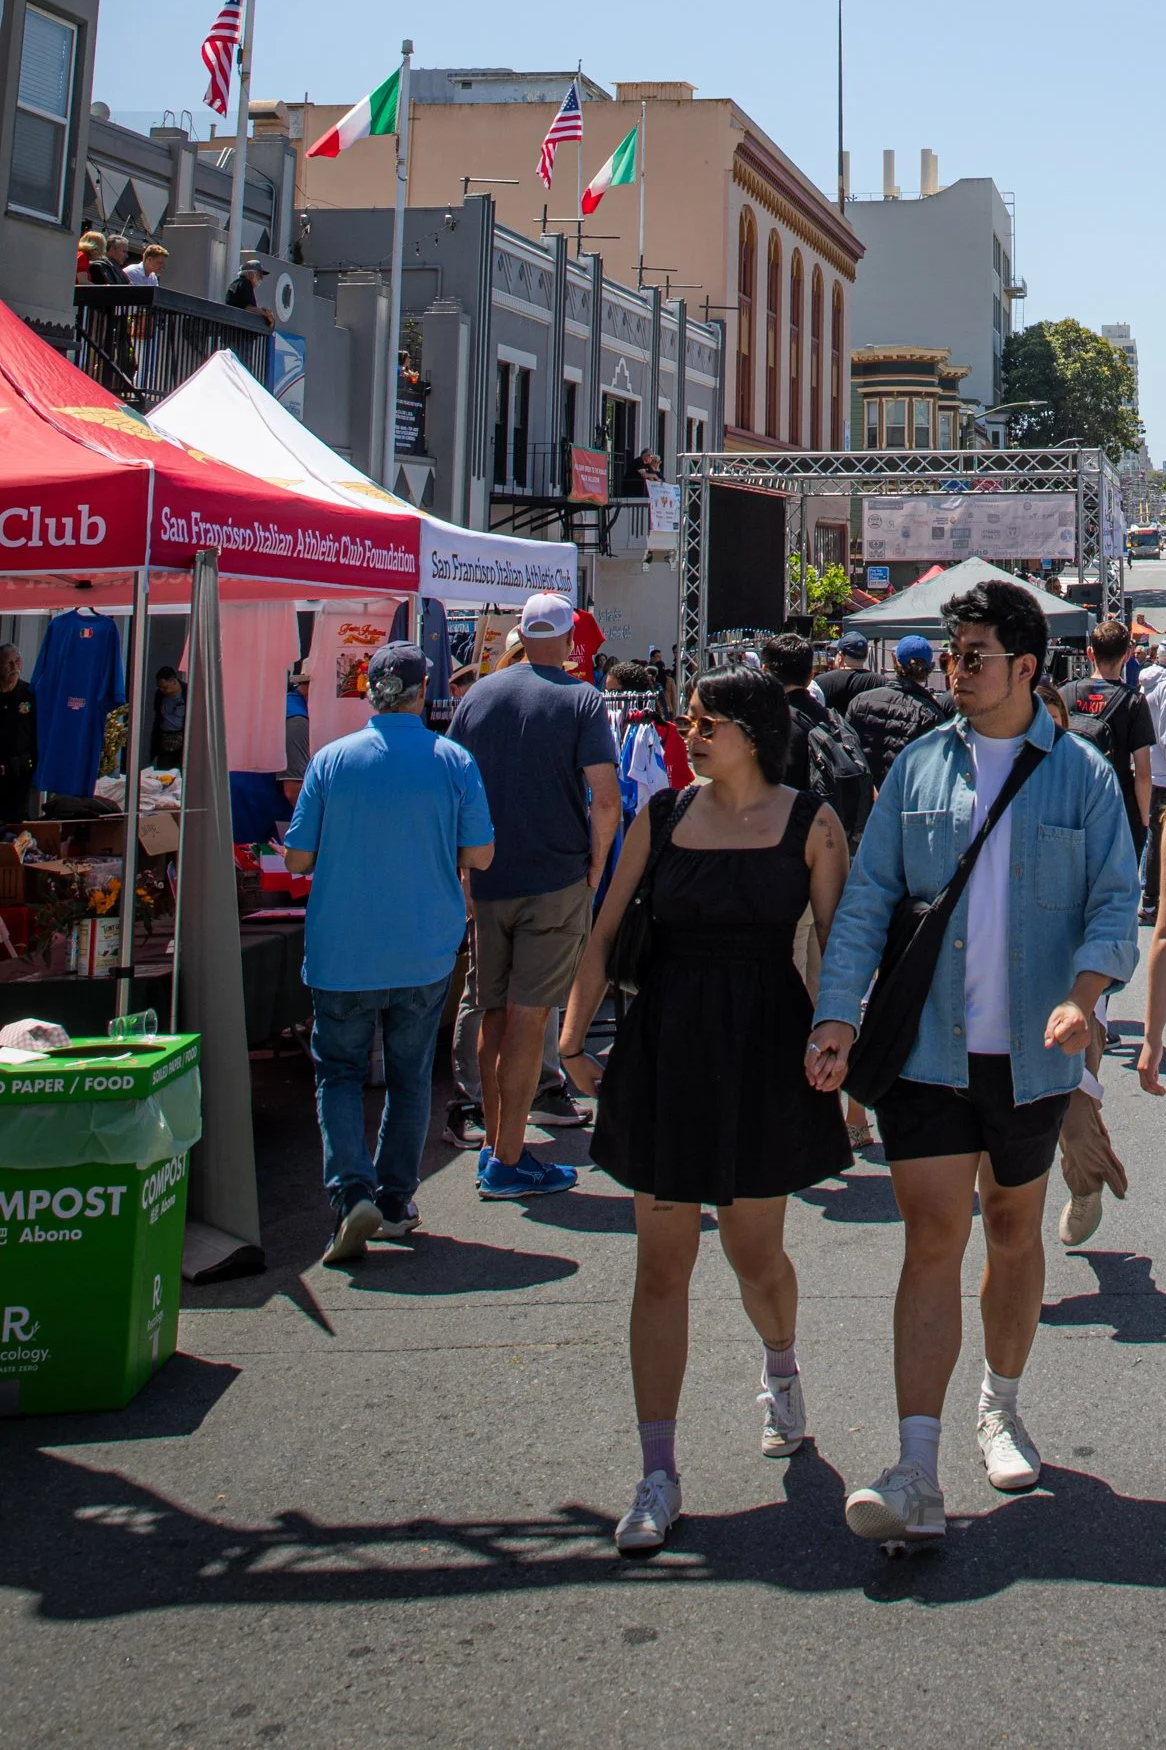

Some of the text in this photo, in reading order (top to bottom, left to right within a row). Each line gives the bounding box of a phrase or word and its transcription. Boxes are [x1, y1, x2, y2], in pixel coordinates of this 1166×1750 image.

[0, 505, 106, 548] Club
[161, 507, 416, 574] San Francisco Italian Athletic Club Foundation
[431, 550, 573, 592] San Francisco Italian Athletic Club
[11, 1076, 134, 1094] PAPER / FOOD
[152, 1067, 168, 1085] SOILED
[168, 1060, 182, 1079] PAPER
[185, 1046, 197, 1065] FOOD
[142, 1153, 187, 1210] COMPOST
[0, 1186, 128, 1221] MPOST
[161, 1194, 176, 1215] Abono
[19, 1225, 83, 1243] Abono
